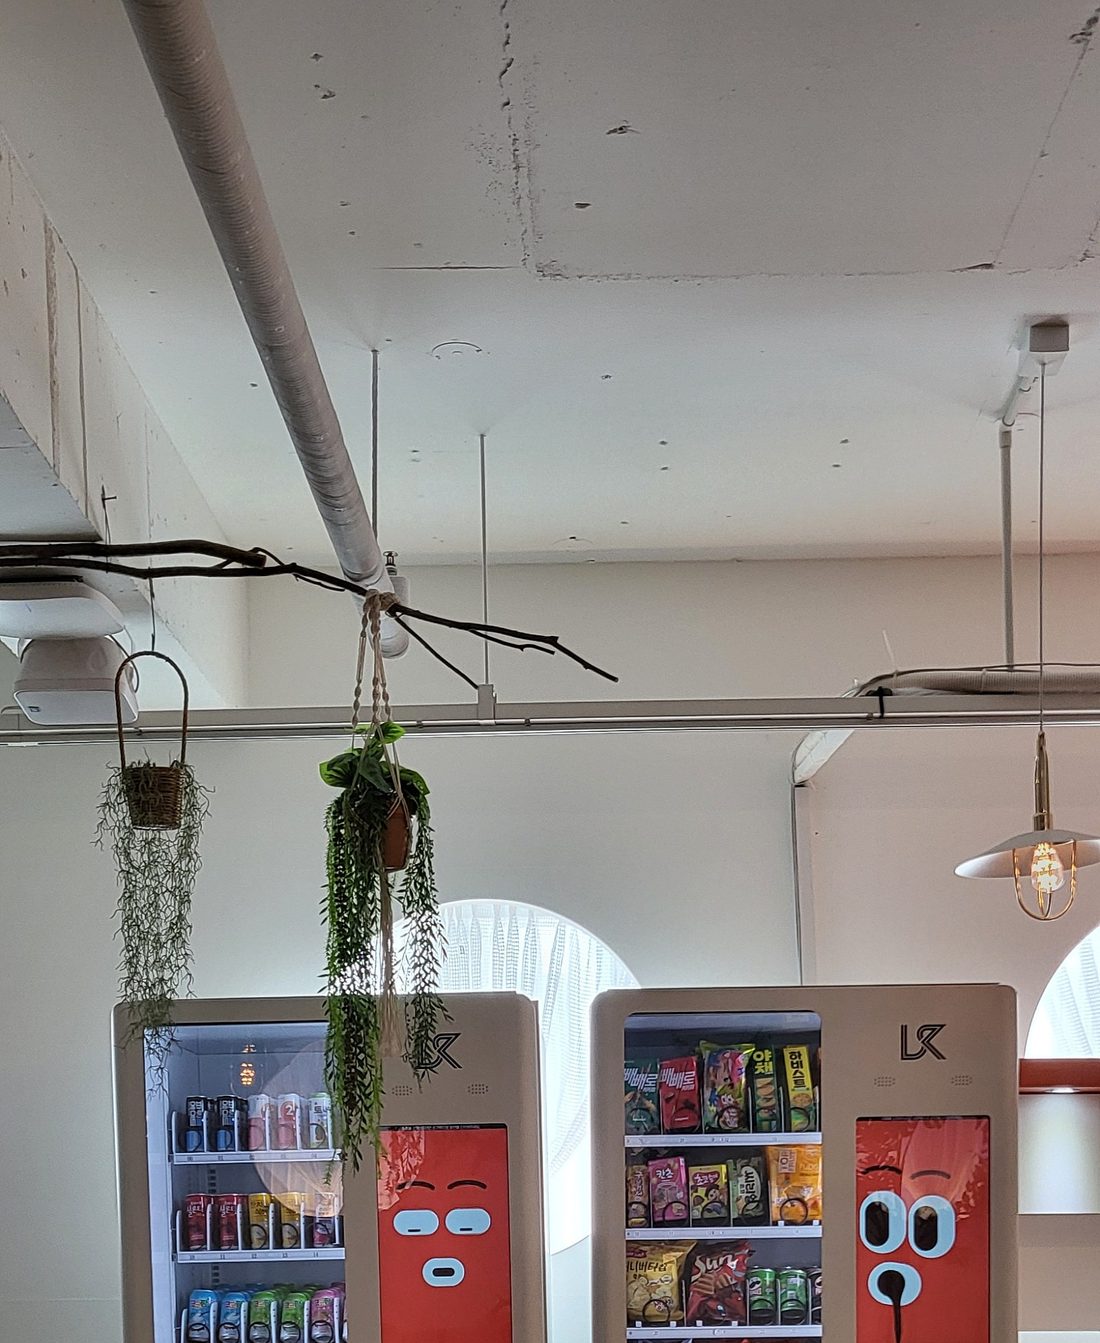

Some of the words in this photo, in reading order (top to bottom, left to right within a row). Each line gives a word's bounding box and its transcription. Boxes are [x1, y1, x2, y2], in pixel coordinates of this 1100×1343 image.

[660, 1067, 696, 1091] 빼빼로
[788, 1051, 806, 1088] 하비스트
[655, 1167, 674, 1180] 칸쵸
[626, 1260, 668, 1273] 니버터칩
[691, 1254, 733, 1283] Sun
